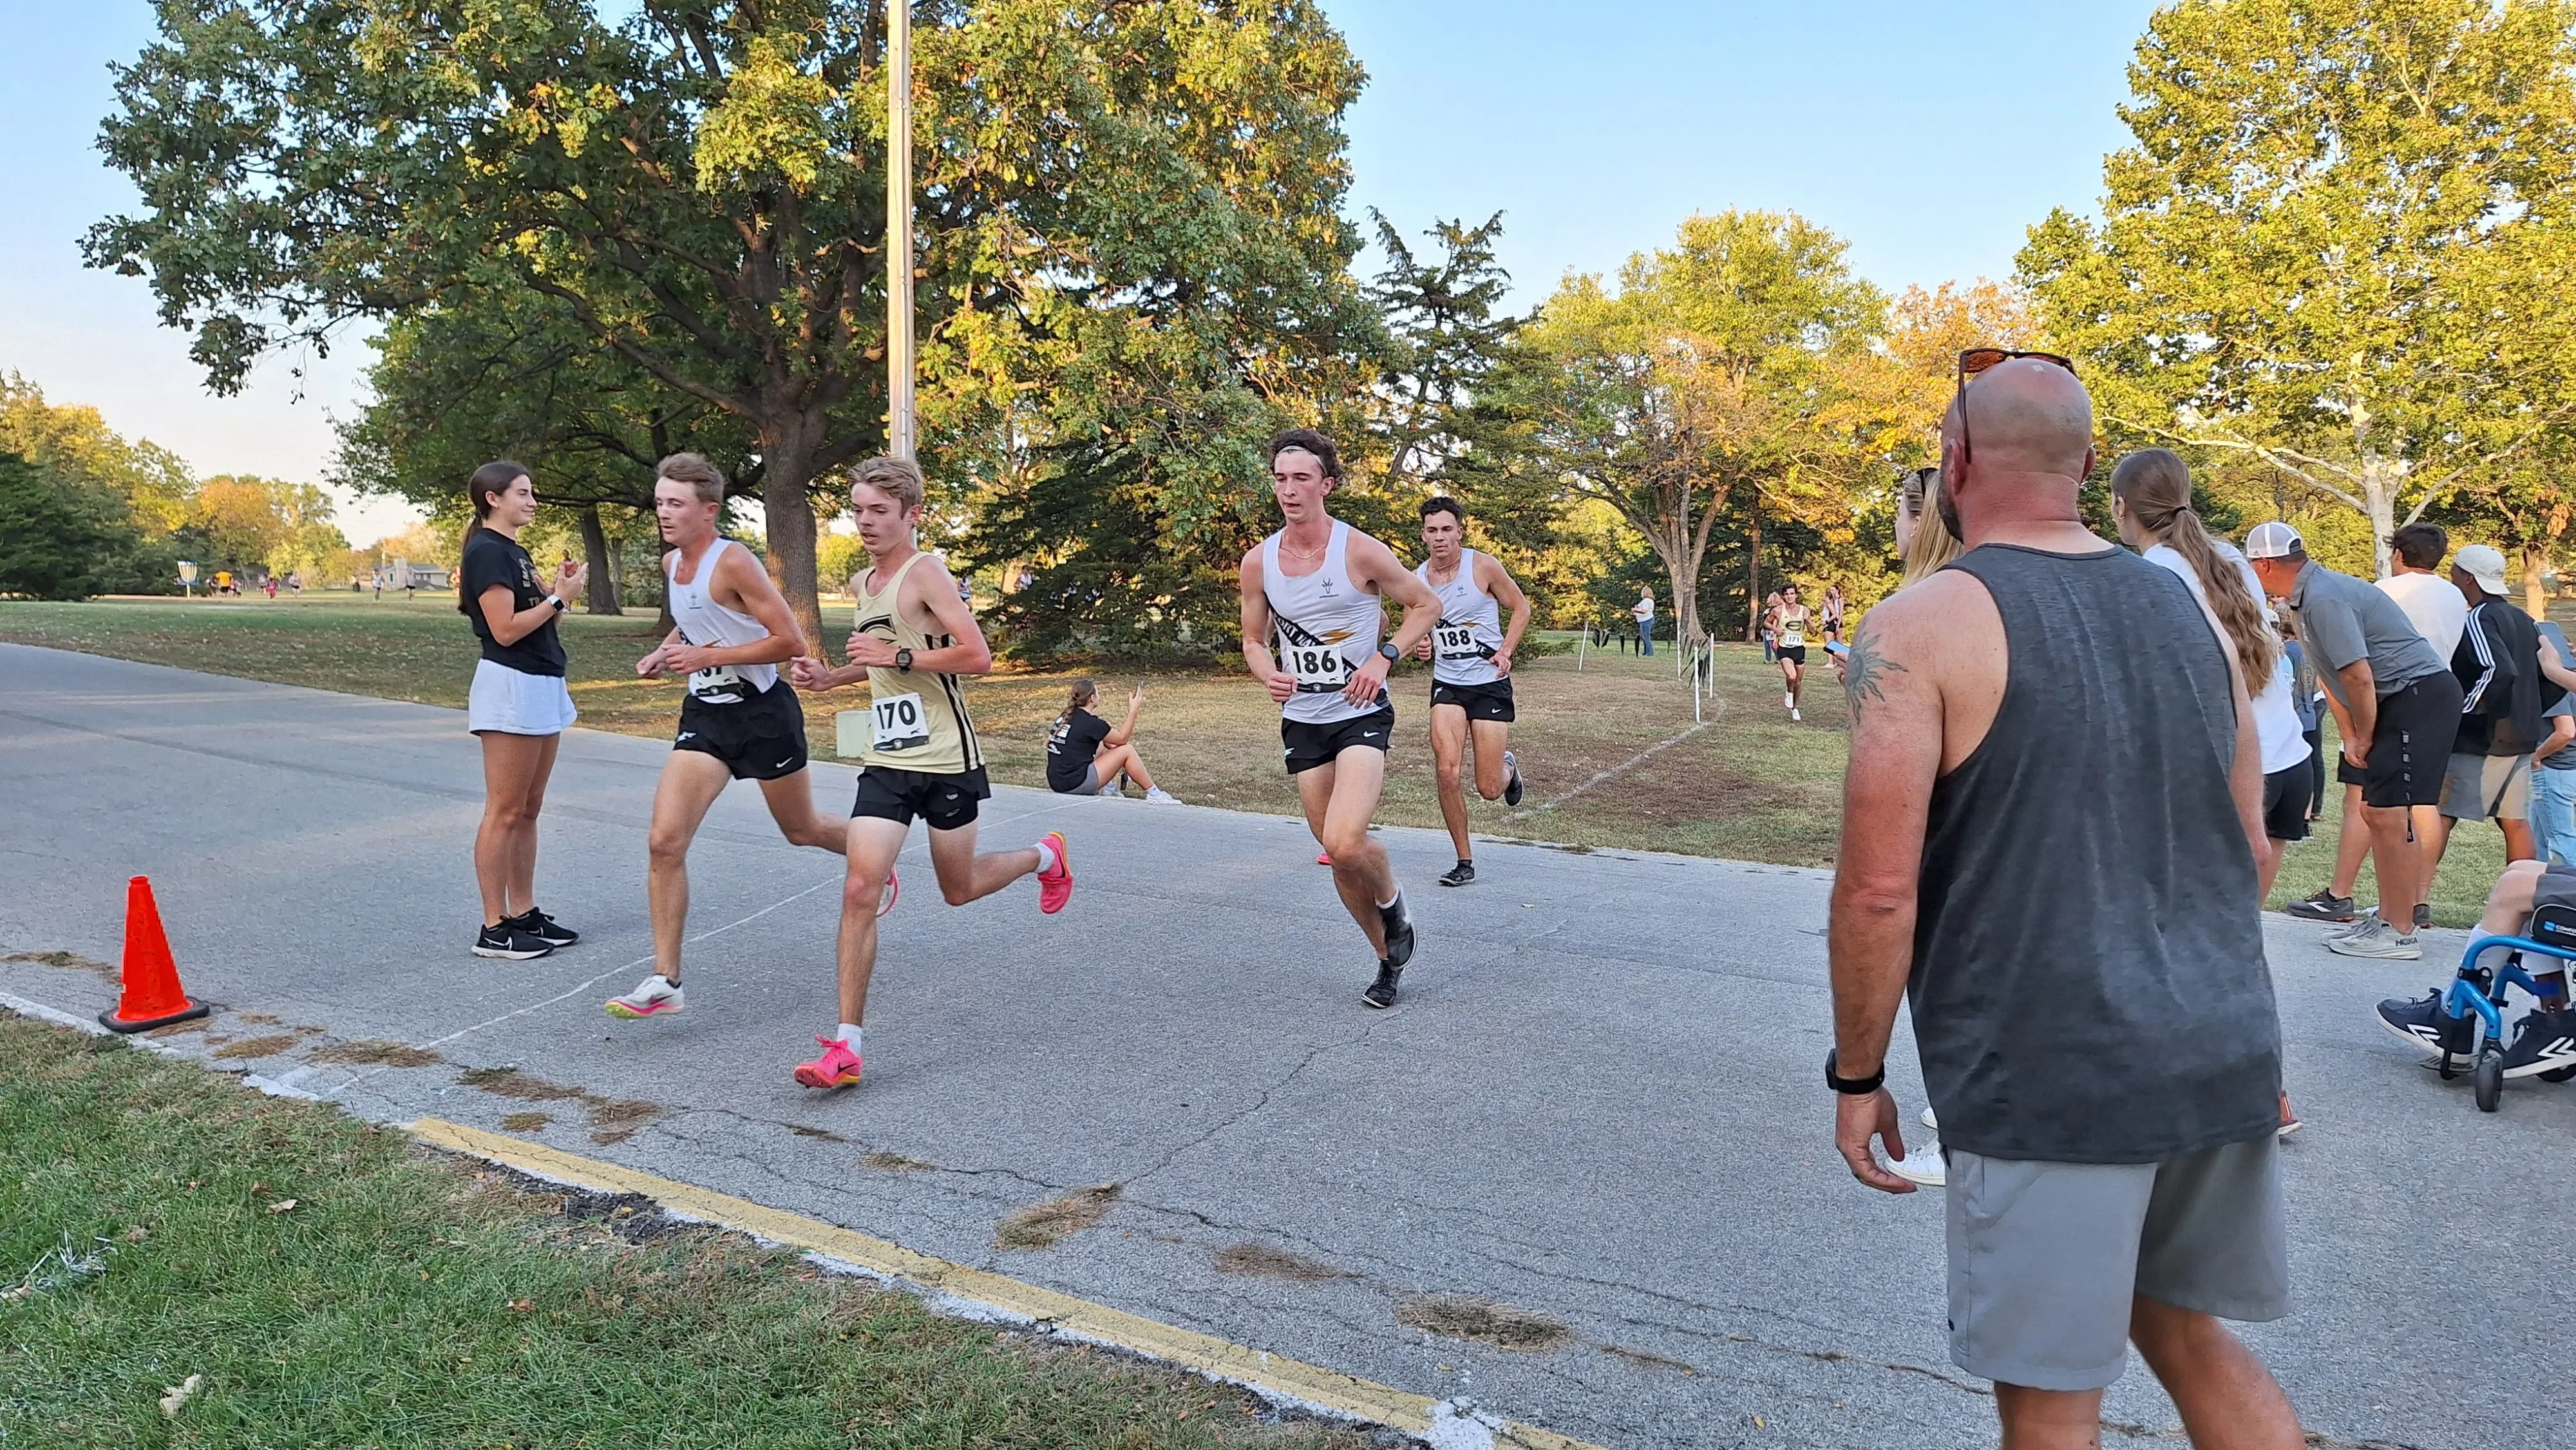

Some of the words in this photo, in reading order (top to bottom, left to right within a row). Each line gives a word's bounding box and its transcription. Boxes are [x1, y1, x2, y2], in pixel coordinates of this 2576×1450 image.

[1439, 629, 1470, 647] 188
[1293, 650, 1336, 674] 186
[876, 700, 916, 729] 170
[2396, 937, 2418, 946] HOKA
